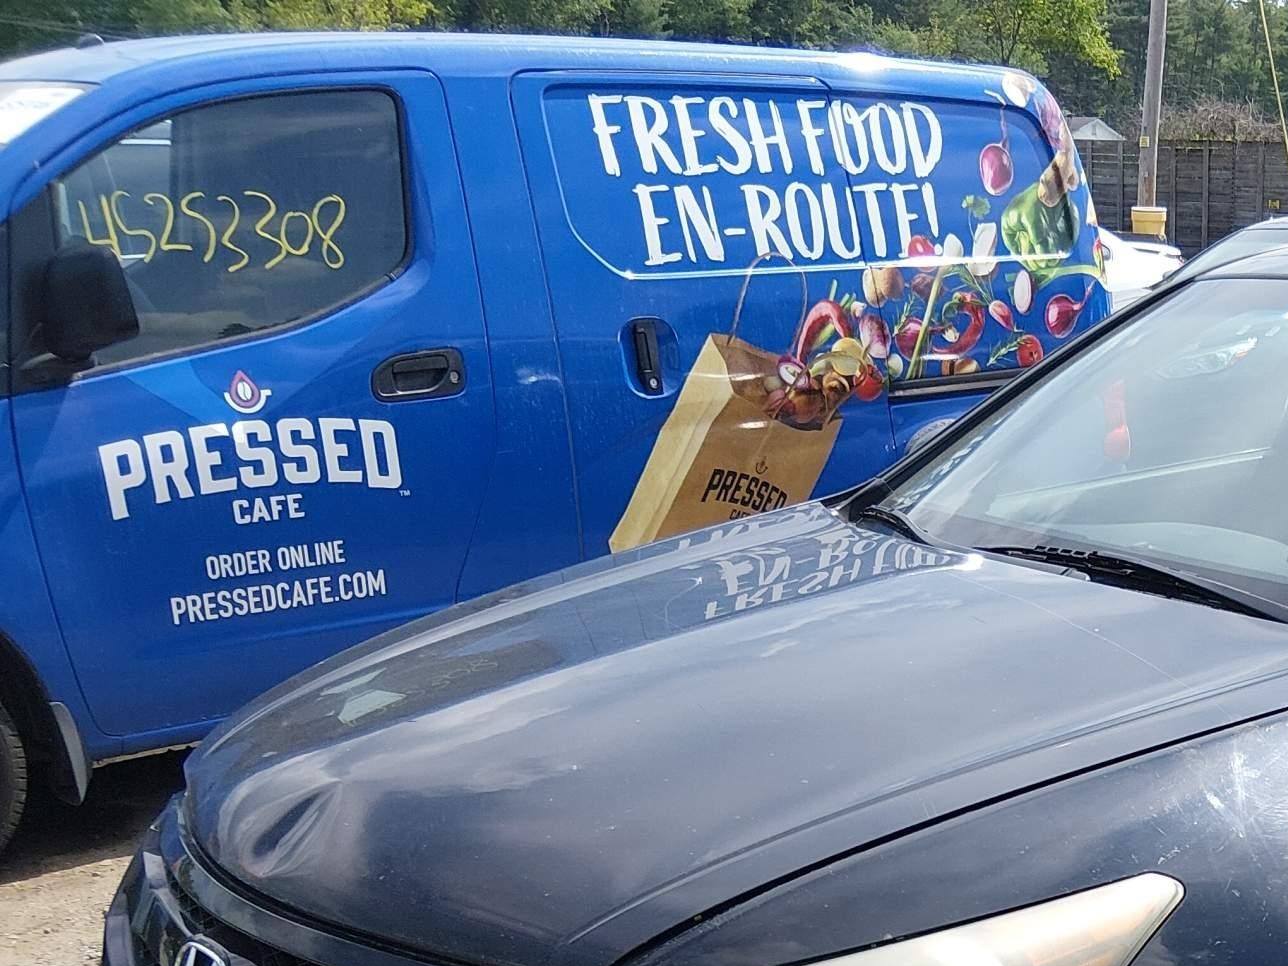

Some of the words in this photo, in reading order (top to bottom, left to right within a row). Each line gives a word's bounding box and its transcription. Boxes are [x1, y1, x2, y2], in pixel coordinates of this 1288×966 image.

[588, 94, 793, 177] FRESH
[797, 99, 943, 178] FOOD
[78, 190, 346, 273] 45253308
[632, 182, 943, 266] EN-ROUTE!
[98, 417, 402, 520] PRESSED
[232, 494, 305, 525] CAFE
[170, 569, 387, 625] PRESSEDCAFE.COM
[205, 550, 272, 580] ORDER
[277, 540, 346, 570] ONLINE
